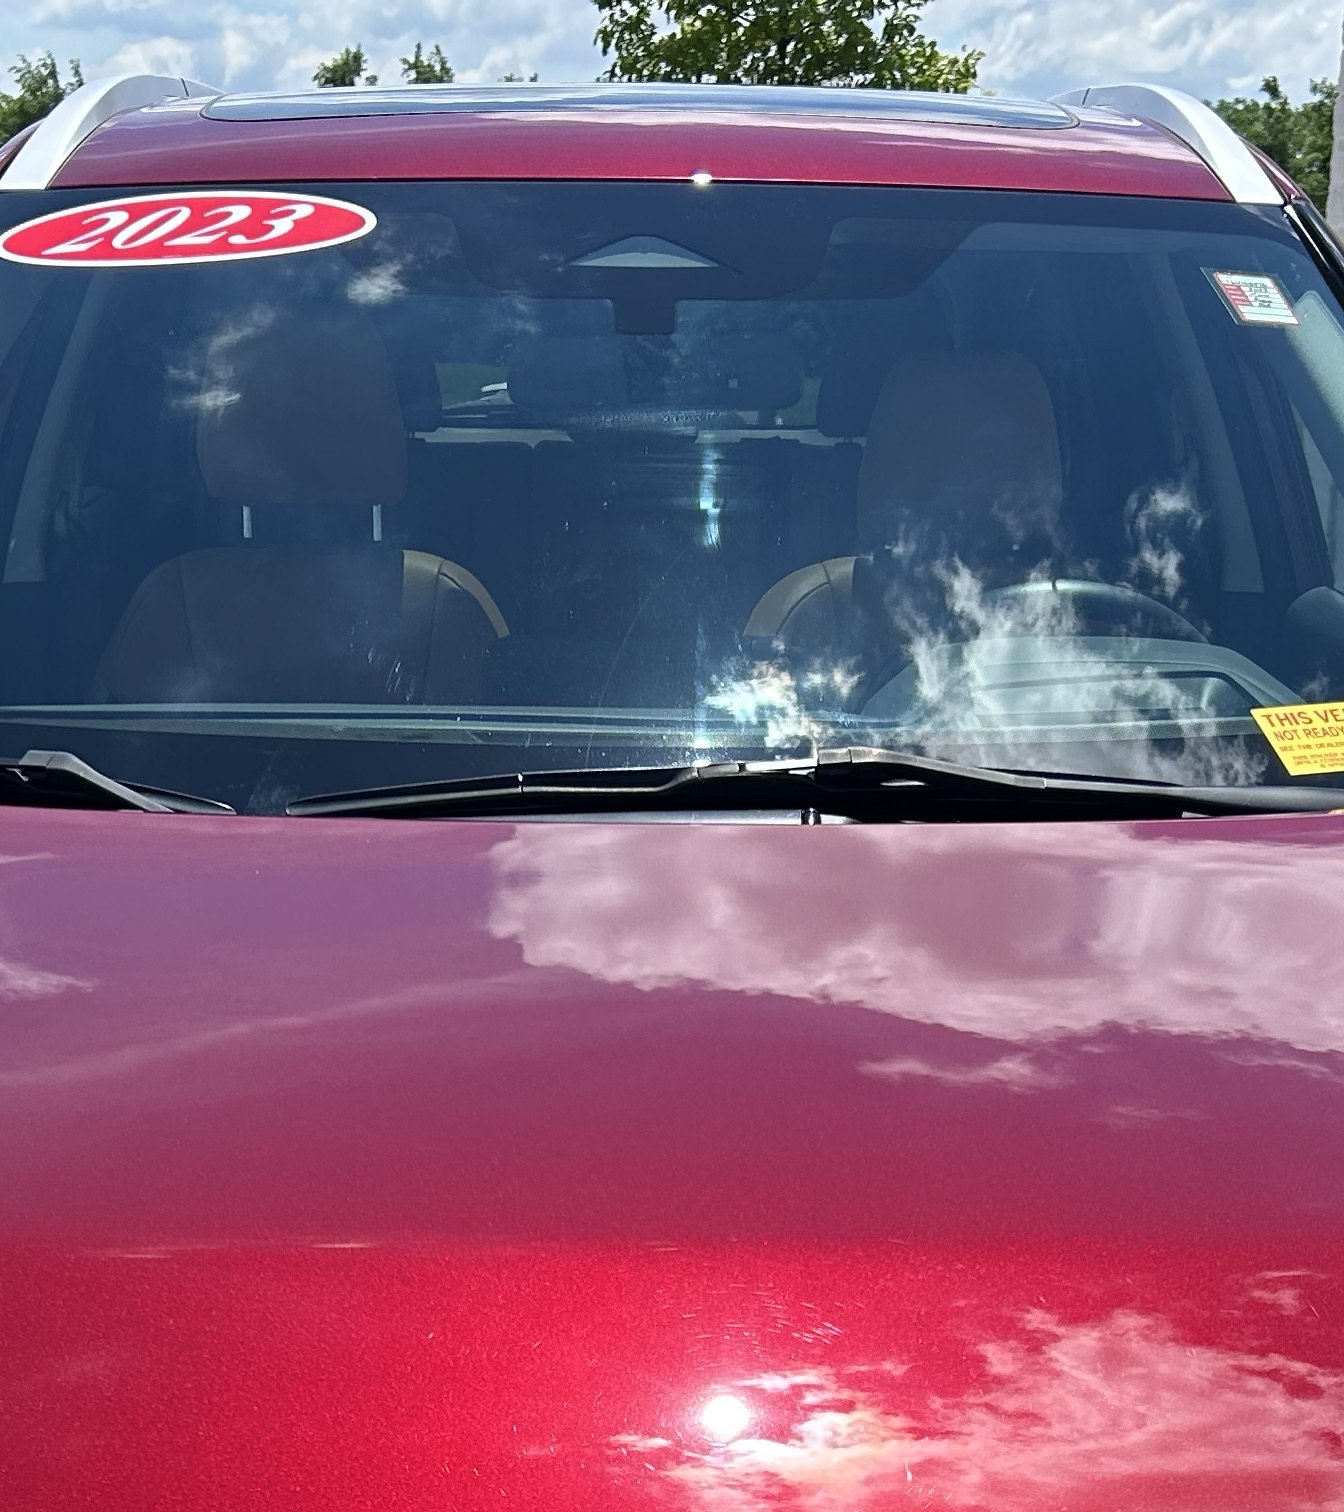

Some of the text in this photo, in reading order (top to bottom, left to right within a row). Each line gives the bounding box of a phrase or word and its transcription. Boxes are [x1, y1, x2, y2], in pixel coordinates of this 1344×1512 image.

[40, 203, 316, 255] 2023
[1261, 711, 1313, 728] THIS
[1273, 729, 1301, 742] NOT
